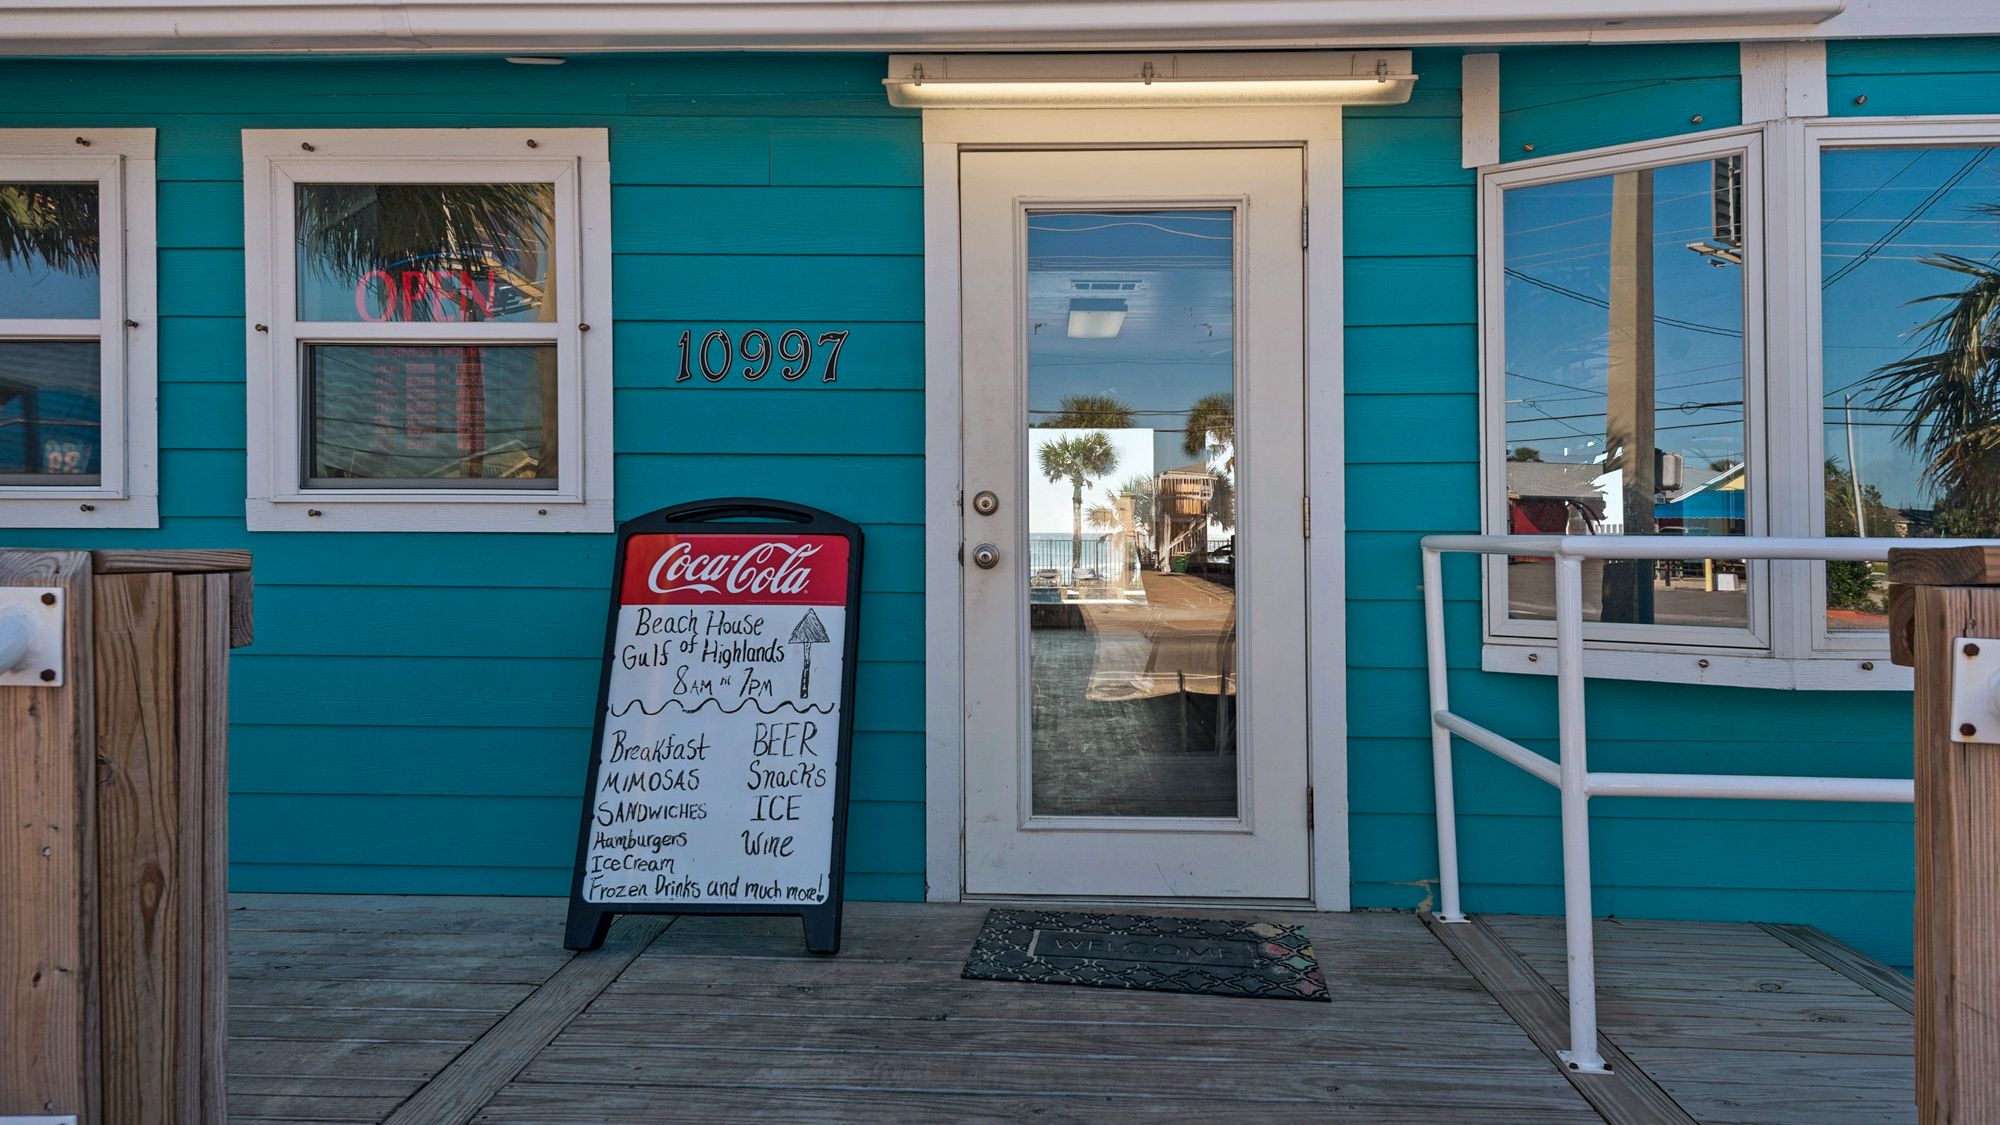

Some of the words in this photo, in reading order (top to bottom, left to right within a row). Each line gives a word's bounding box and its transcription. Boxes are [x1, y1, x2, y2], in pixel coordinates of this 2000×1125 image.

[355, 269, 495, 322] OPEN
[675, 328, 849, 382] 10997
[648, 542, 824, 595] Coca-Cola
[635, 607, 699, 636] Beach
[705, 610, 765, 636] House
[622, 640, 671, 670] Gulf
[680, 636, 699, 657] of
[701, 638, 785, 669] Highlands
[673, 665, 713, 696] 8AM
[739, 667, 773, 697] 7PM
[610, 730, 711, 763] Breakfast
[753, 721, 818, 757] BEER
[602, 768, 700, 794] MIMOSAS
[596, 801, 708, 827] SANDWICHES
[750, 795, 803, 822] ICE
[593, 828, 688, 852] Hamburgers
[741, 830, 794, 858] Wine
[589, 875, 648, 901] Frozen
[654, 874, 701, 898] Drinks
[706, 876, 740, 898] and
[745, 880, 783, 900] much
[1055, 938, 1234, 961] WELCOME
